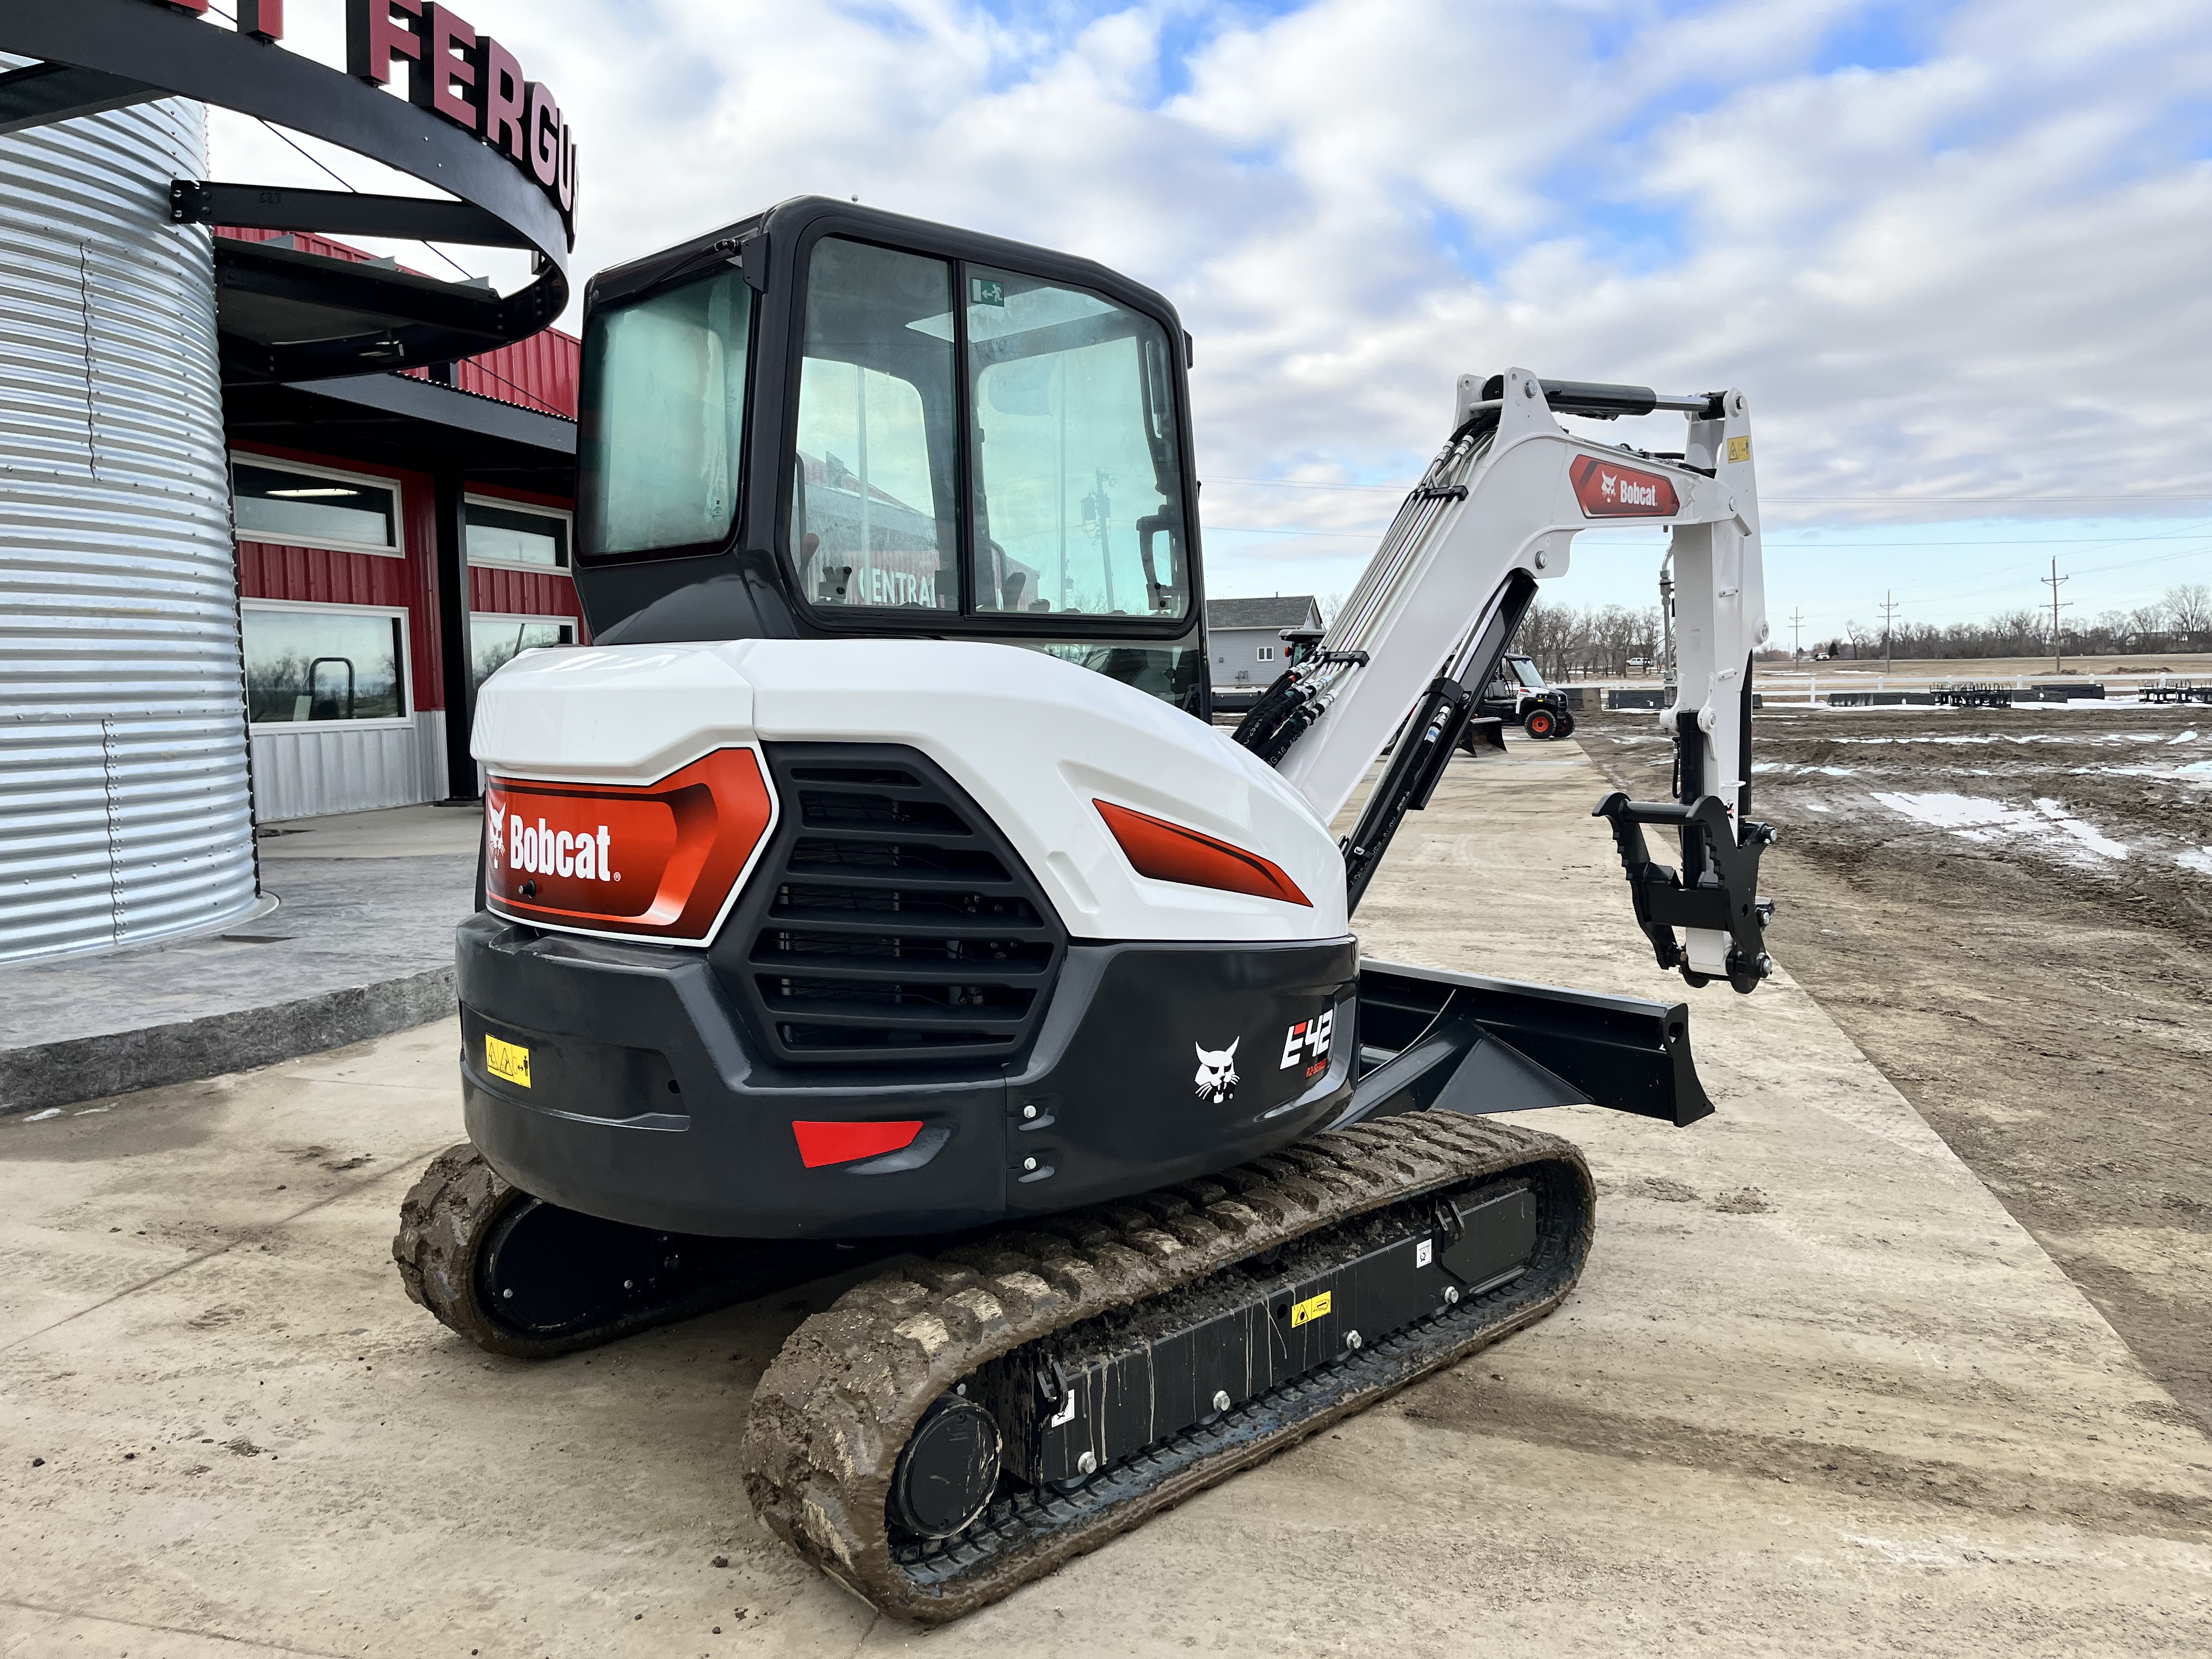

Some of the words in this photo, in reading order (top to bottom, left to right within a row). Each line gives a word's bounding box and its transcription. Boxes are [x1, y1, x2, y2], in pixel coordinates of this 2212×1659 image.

[1620, 480, 1656, 506] Bobcat
[510, 814, 611, 882] Bobcat
[1279, 1009, 1334, 1070] E42
